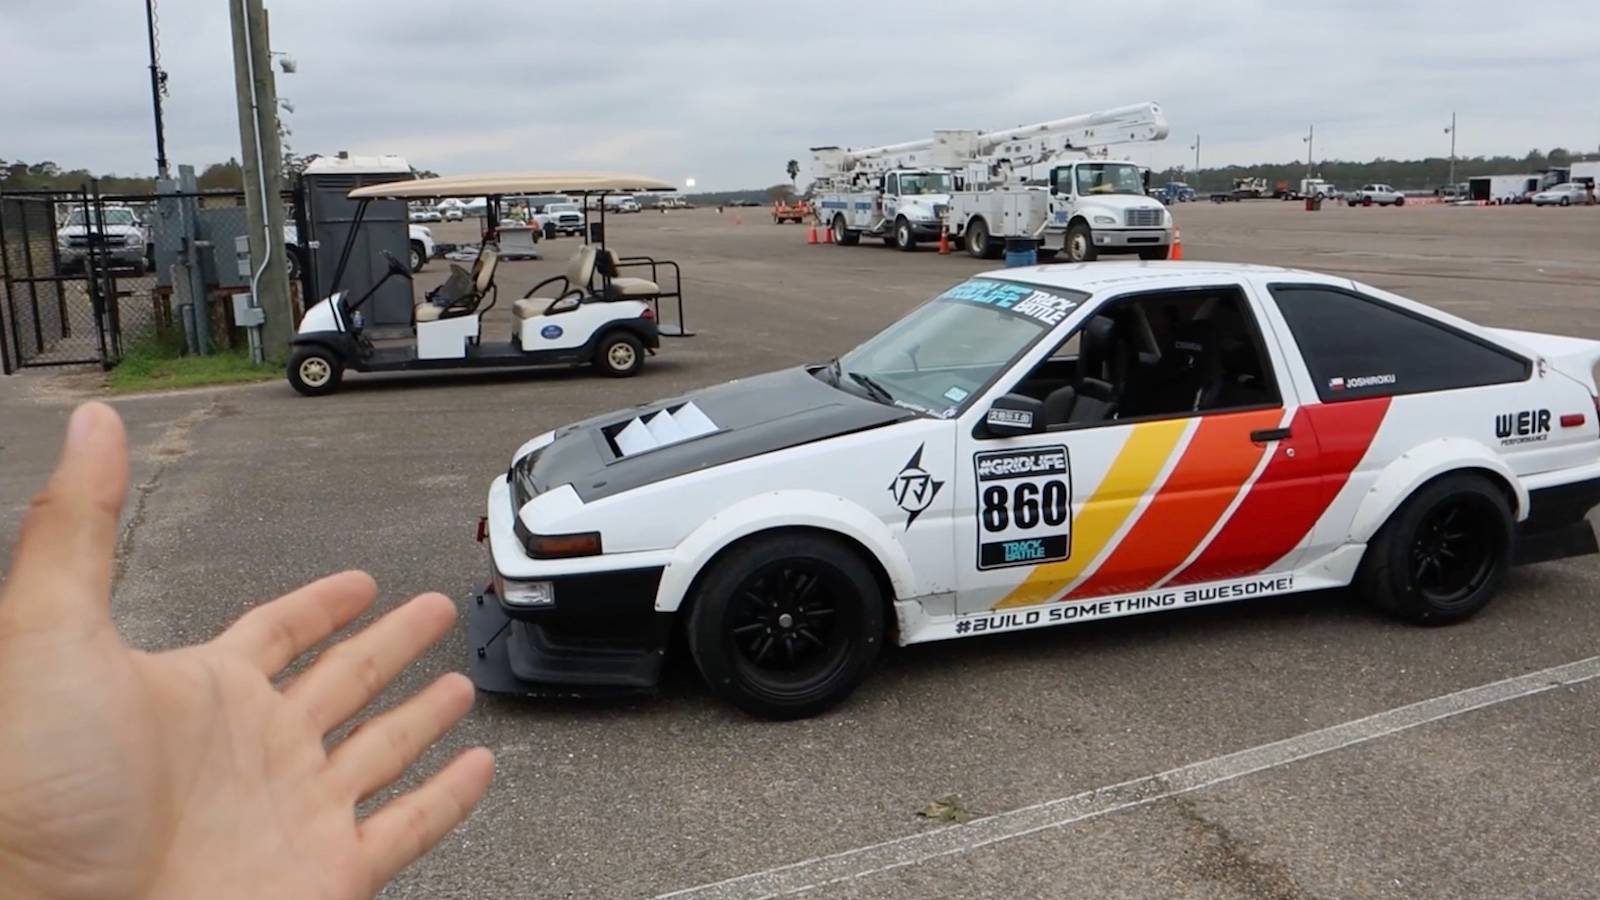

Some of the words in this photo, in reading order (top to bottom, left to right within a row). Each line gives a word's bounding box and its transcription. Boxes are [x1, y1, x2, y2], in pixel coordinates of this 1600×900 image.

[1024, 290, 1077, 311] TRACK
[1011, 301, 1067, 325] BATTLE
[1496, 409, 1551, 438] WEIR
[979, 453, 1066, 476] #GRIDLIFE
[983, 480, 1067, 532] 860
[1002, 539, 1042, 552] TRACK
[1005, 547, 1046, 561] BATTLE
[955, 611, 1040, 634] #BUILD
[1049, 593, 1176, 621] SOMETHING
